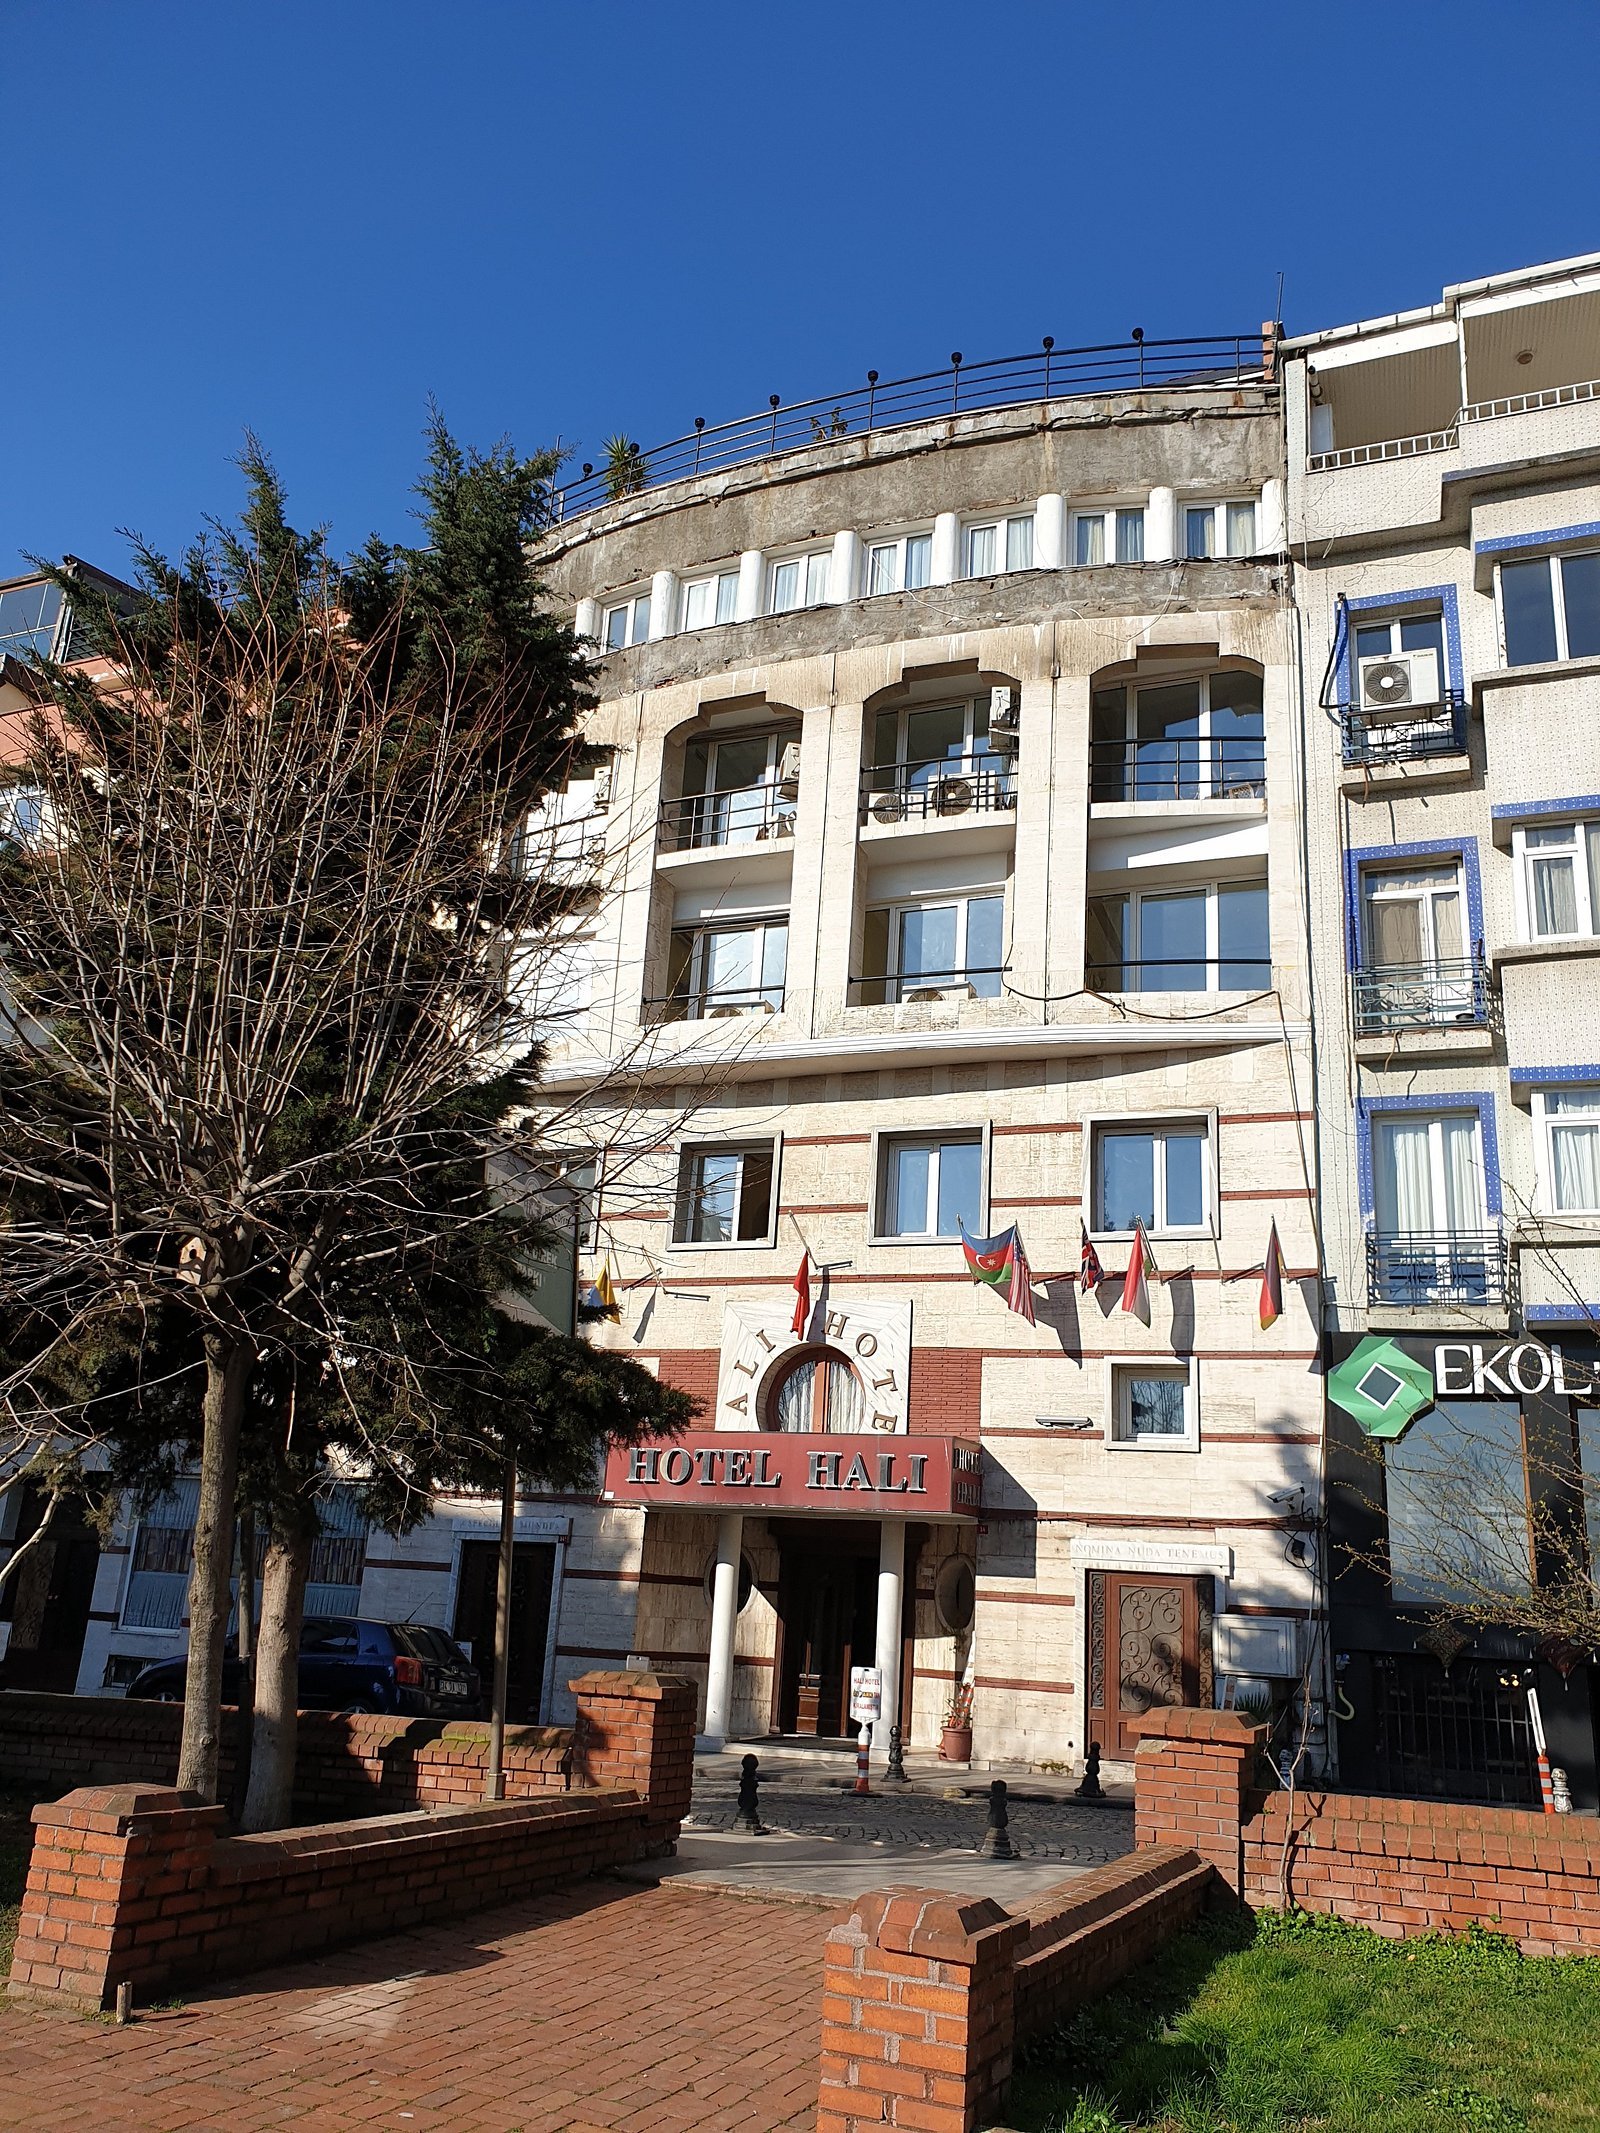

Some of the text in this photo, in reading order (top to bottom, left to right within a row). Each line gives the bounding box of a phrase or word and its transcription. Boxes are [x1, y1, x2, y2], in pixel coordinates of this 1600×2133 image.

[726, 1310, 898, 1433] ALI HOTE
[1434, 1343, 1592, 1395] EKOL
[625, 1447, 927, 1494] HOTEL HALI
[1074, 1543, 1121, 1556] NOMINA
[1128, 1546, 1161, 1558] NUDA
